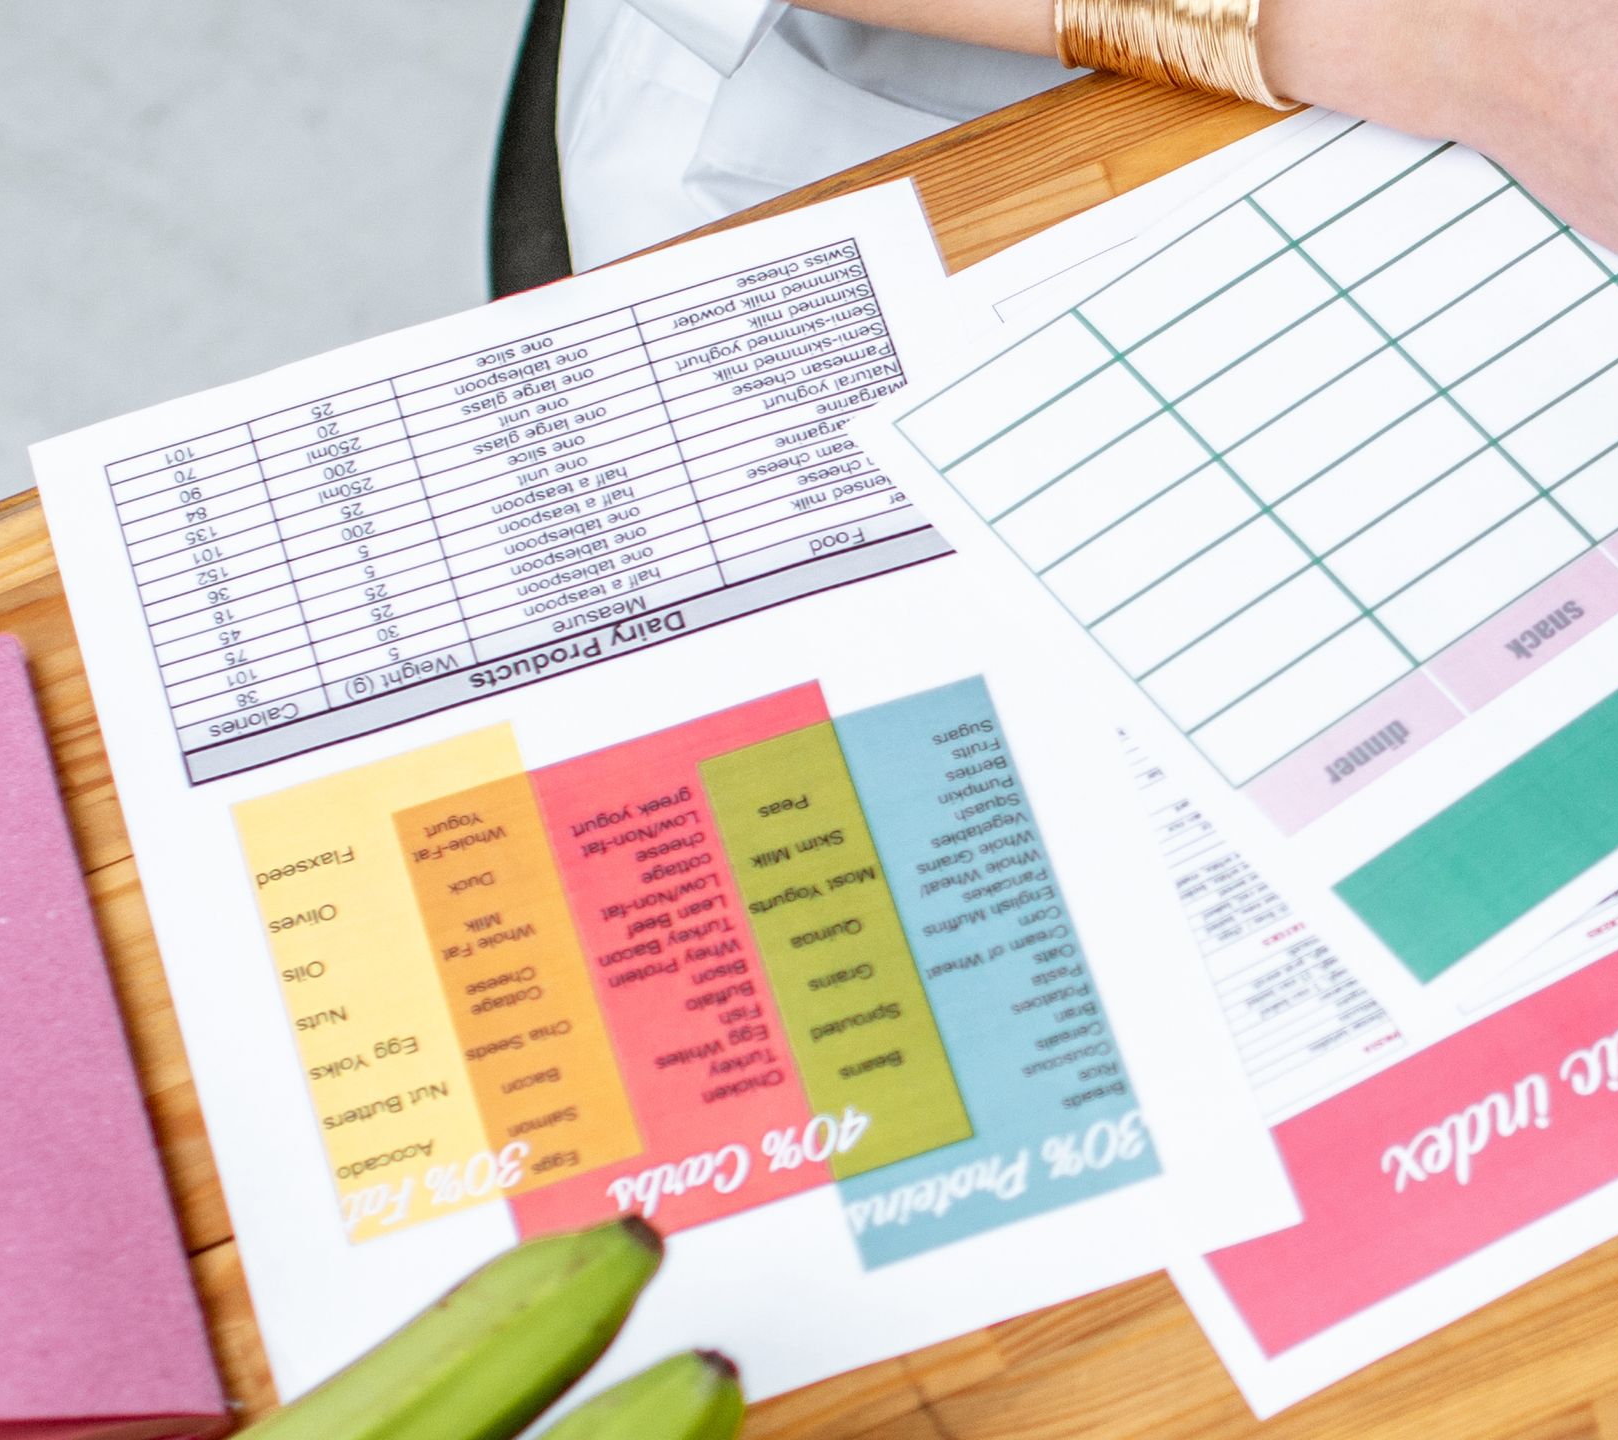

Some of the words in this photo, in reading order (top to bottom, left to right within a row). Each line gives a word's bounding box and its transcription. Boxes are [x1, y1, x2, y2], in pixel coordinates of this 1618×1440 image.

[804, 245, 855, 266] Swiss
[737, 262, 798, 287] cheese
[781, 264, 861, 297] Skimmed
[740, 290, 775, 308] milk
[788, 283, 868, 317] Skimmed
[673, 300, 735, 328] powder
[747, 302, 876, 350] Semi-skimmed
[748, 310, 782, 327] milk
[477, 348, 515, 366] slice
[521, 337, 552, 353] one
[556, 348, 587, 364] one
[676, 340, 741, 370] yoghurt
[753, 322, 882, 370] Semi-skimmed
[801, 342, 890, 375] Parmesan
[454, 359, 550, 394] tablespoon
[562, 368, 593, 384] one
[713, 363, 748, 380] milk
[733, 370, 795, 394] cheese
[834, 362, 896, 389] Natural
[513, 380, 556, 399] large
[763, 379, 828, 409] yoghurt
[311, 402, 332, 418] 25
[461, 391, 507, 414] glass
[536, 397, 568, 413] one
[575, 407, 606, 423] one
[317, 422, 338, 438] 20
[499, 409, 530, 426] unit
[525, 418, 568, 437] large
[307, 437, 361, 462] 250ml
[473, 430, 519, 454] glass
[553, 435, 584, 451] one
[165, 447, 193, 464] 101
[508, 446, 546, 465] slice
[555, 456, 587, 472] one
[174, 468, 196, 482] 70
[324, 460, 356, 479] 200
[517, 468, 548, 485] unit
[180, 487, 201, 502] 90
[318, 477, 373, 502] 250ml
[186, 506, 207, 522] 84
[341, 502, 362, 518] 25
[186, 527, 216, 544] 135
[342, 521, 374, 540] 200
[809, 528, 864, 554] Food
[193, 547, 221, 563] 101
[197, 567, 227, 584] 152
[553, 596, 646, 632] Measure
[606, 610, 685, 645] Dairy
[1505, 600, 1584, 658] snack
[381, 654, 458, 687] Weight
[469, 637, 601, 687] Products
[345, 676, 373, 699] (g)
[209, 702, 298, 736] Calories
[932, 719, 993, 744] Sugars
[951, 737, 1001, 759] Fruits
[1325, 719, 1409, 783] dinner
[945, 755, 1008, 781] Berries
[937, 774, 1014, 804] Pumpkin
[757, 794, 809, 817] Peas
[954, 792, 1020, 821] Squash
[423, 812, 483, 838] Yogurt
[930, 812, 1028, 848] Vegetables
[412, 826, 506, 862] Whole-Fat
[794, 829, 844, 852] Skim
[255, 846, 354, 888] Flaxseed
[751, 847, 790, 867] Milk
[447, 871, 495, 894] Duck
[826, 866, 876, 890] Most
[962, 867, 1048, 902] Pancakes
[677, 894, 726, 918] Lean
[748, 885, 822, 914] Yogurts
[268, 903, 337, 933] Olives
[464, 912, 501, 931] Milk
[627, 912, 672, 938] Beef
[477, 923, 535, 948] Whole
[667, 917, 734, 945] Turkey
[790, 918, 862, 948] Quinoa
[442, 943, 473, 960] Fat
[598, 939, 663, 967] Bacon
[684, 938, 741, 963] Whey
[282, 960, 325, 982] Oils
[465, 966, 535, 995] Cheese
[608, 958, 679, 987] Protein
[691, 958, 748, 985] Bison
[807, 962, 873, 990] Grains
[471, 985, 542, 1014] Cottage
[685, 979, 755, 1010] Buffalo
[295, 1006, 347, 1030] Nuts
[718, 1002, 762, 1024] Fish
[810, 1002, 901, 1042] Sprouted
[528, 1019, 571, 1040] Chia
[728, 1023, 769, 1045] Egg
[373, 1036, 418, 1058] Egg
[465, 1034, 524, 1060] Seeds
[654, 1039, 723, 1069] Whites
[309, 1054, 369, 1079] Yolks
[709, 1048, 776, 1076] Turkey
[839, 1050, 903, 1078] Beans
[501, 1066, 561, 1093] Bacon
[701, 1069, 784, 1103] Chicken
[408, 1081, 448, 1104] Nut
[322, 1095, 403, 1129] Butters
[507, 1106, 577, 1137] Salmon
[761, 1105, 872, 1171] 40%
[1040, 1110, 1143, 1178] 30%
[1381, 1073, 1549, 1192] index
[336, 1139, 433, 1179] Acocado
[424, 1138, 532, 1204] 30%
[531, 1150, 579, 1174] Eggs
[606, 1144, 749, 1216] Carbs
[845, 1149, 1029, 1233] Proteins
[342, 1175, 415, 1228] Fat
